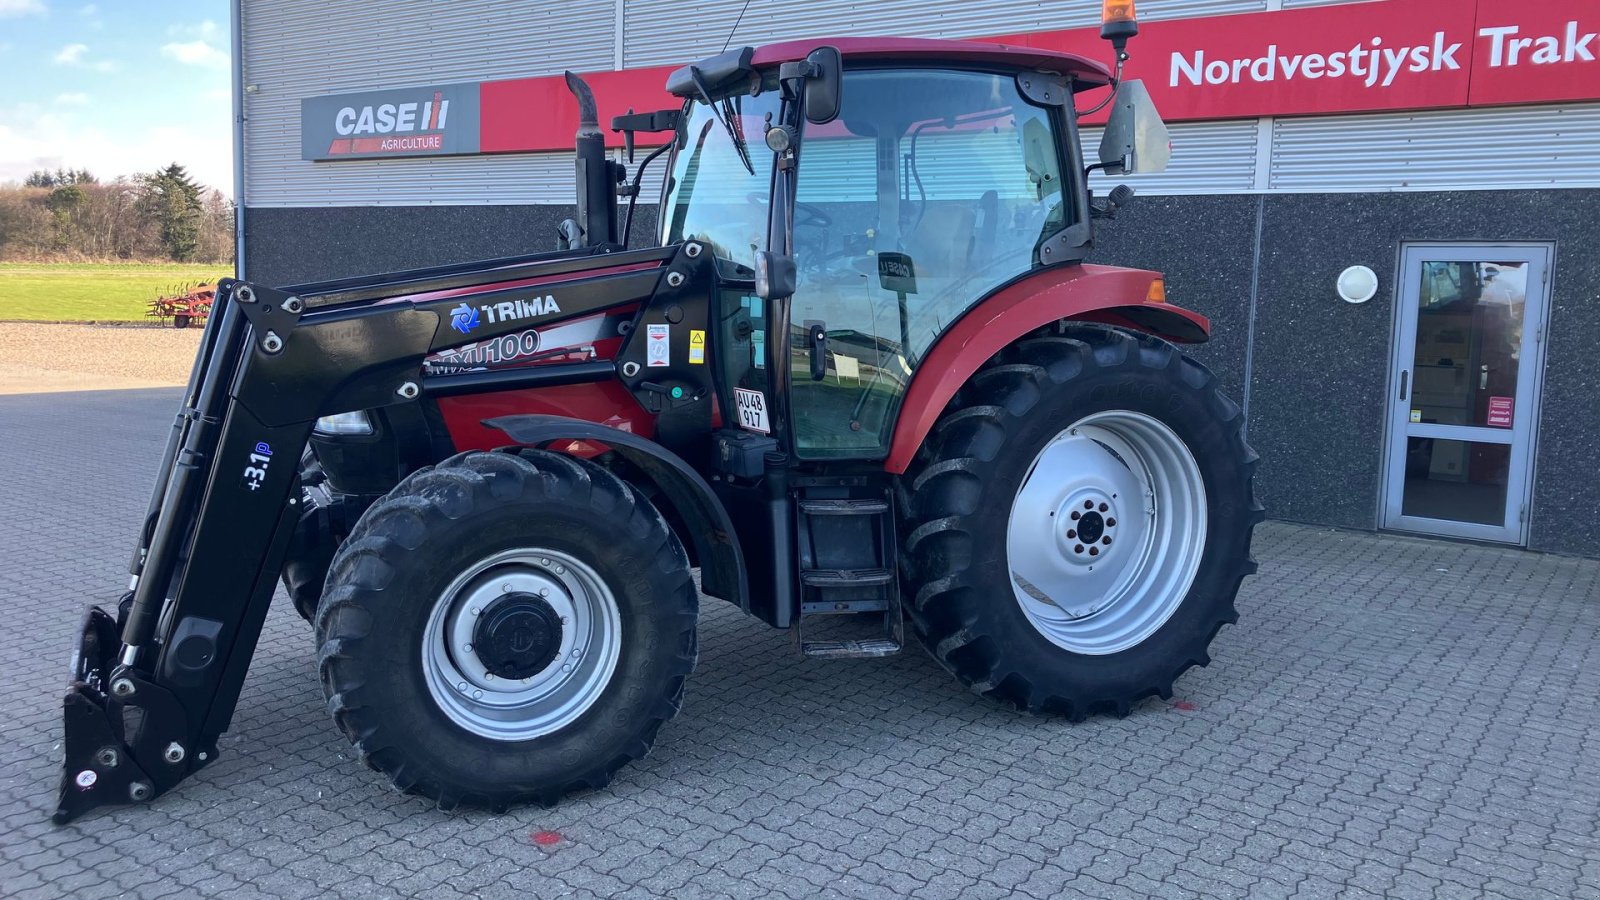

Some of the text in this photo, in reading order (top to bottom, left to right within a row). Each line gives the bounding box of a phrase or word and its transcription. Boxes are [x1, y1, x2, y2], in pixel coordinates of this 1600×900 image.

[1169, 20, 1600, 88] Nordvestjysk Trak
[335, 102, 418, 136] CASE
[381, 136, 440, 150] AGRICULTURE
[481, 295, 561, 324] TRIMA
[737, 392, 763, 412] AU48
[743, 410, 761, 428] 917
